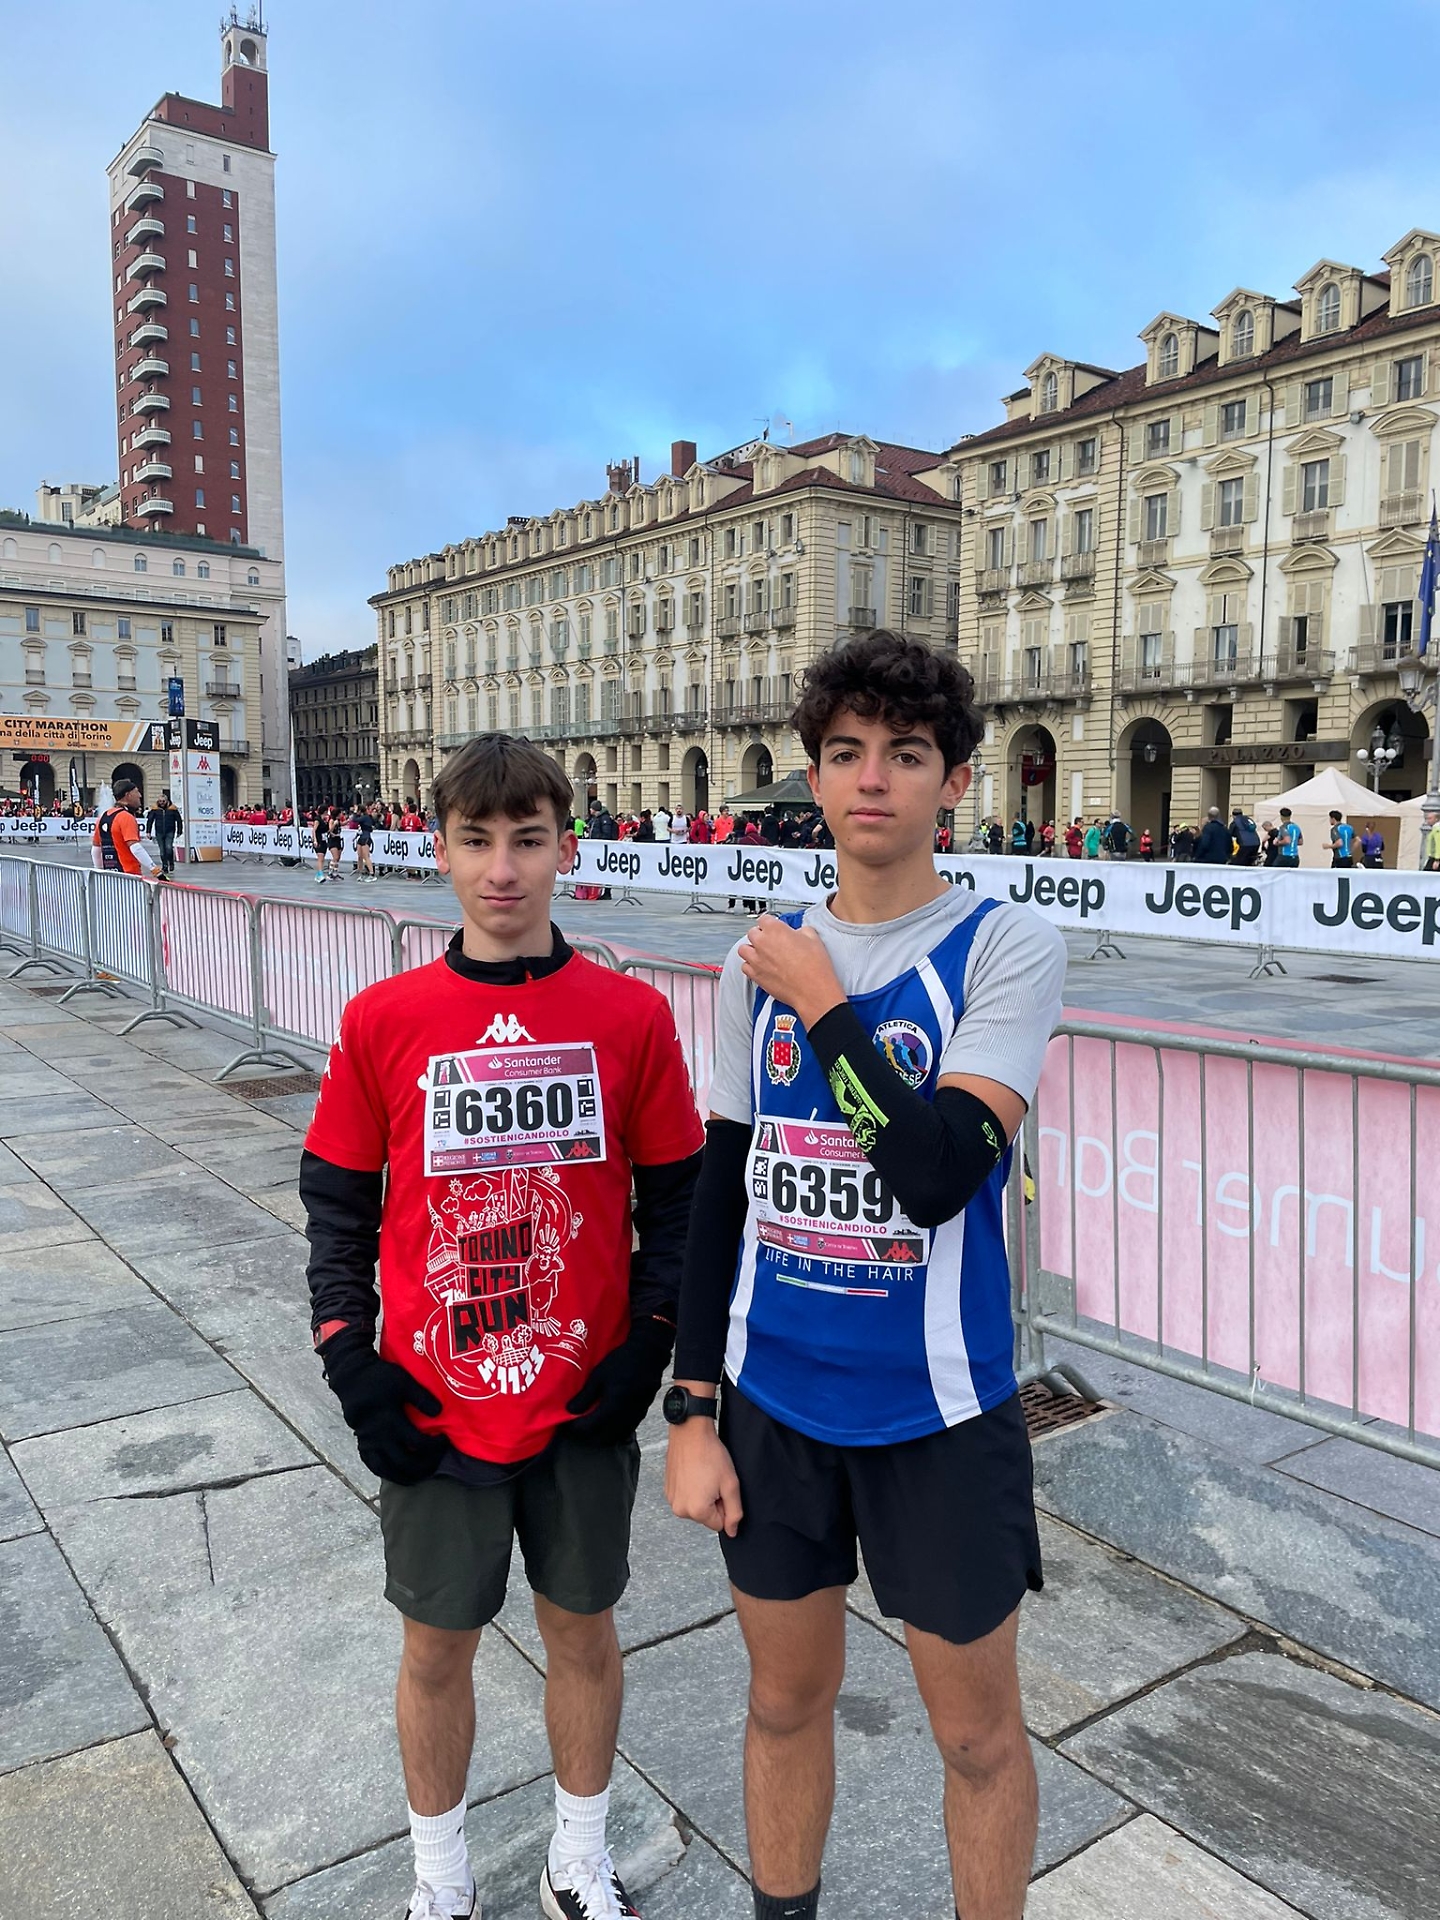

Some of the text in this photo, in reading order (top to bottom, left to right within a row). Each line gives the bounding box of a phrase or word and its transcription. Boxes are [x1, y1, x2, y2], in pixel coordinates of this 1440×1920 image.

[4, 719, 108, 732] CITY MARATHON
[15, 729, 41, 738] della
[43, 731, 65, 739] città
[67, 731, 78, 739] di
[80, 731, 112, 741] Torino
[193, 733, 213, 750] Jeep
[1208, 746, 1305, 762] PALAZZO
[11, 820, 48, 832] Jeep
[61, 820, 97, 833] Jeep
[226, 826, 244, 844] Jeep
[249, 828, 268, 846] Jeep
[273, 830, 293, 849] Jeep
[383, 833, 409, 861] Jeep
[597, 844, 641, 880] Jeep
[658, 847, 708, 885] Jeep
[727, 850, 783, 891] Jeep
[804, 854, 839, 890] Je
[1009, 863, 1106, 918] Jeep
[1145, 870, 1262, 931] Jeep
[877, 1021, 918, 1034] ATLETICA
[504, 1055, 562, 1068] Santander
[504, 1066, 562, 1077] Consumer Bank
[455, 1082, 574, 1136] 6360
[464, 1129, 570, 1145] #SOSTIENICANDIOLO
[820, 1147, 861, 1159] Consumer
[772, 1161, 893, 1224] 6359
[779, 1214, 887, 1234] #SOSTIENICANDIOLO
[459, 1220, 533, 1262] TORINO
[765, 1247, 914, 1281] LIFE IN THE HAIR
[468, 1265, 521, 1297] CITY
[453, 1291, 530, 1353] RUN
